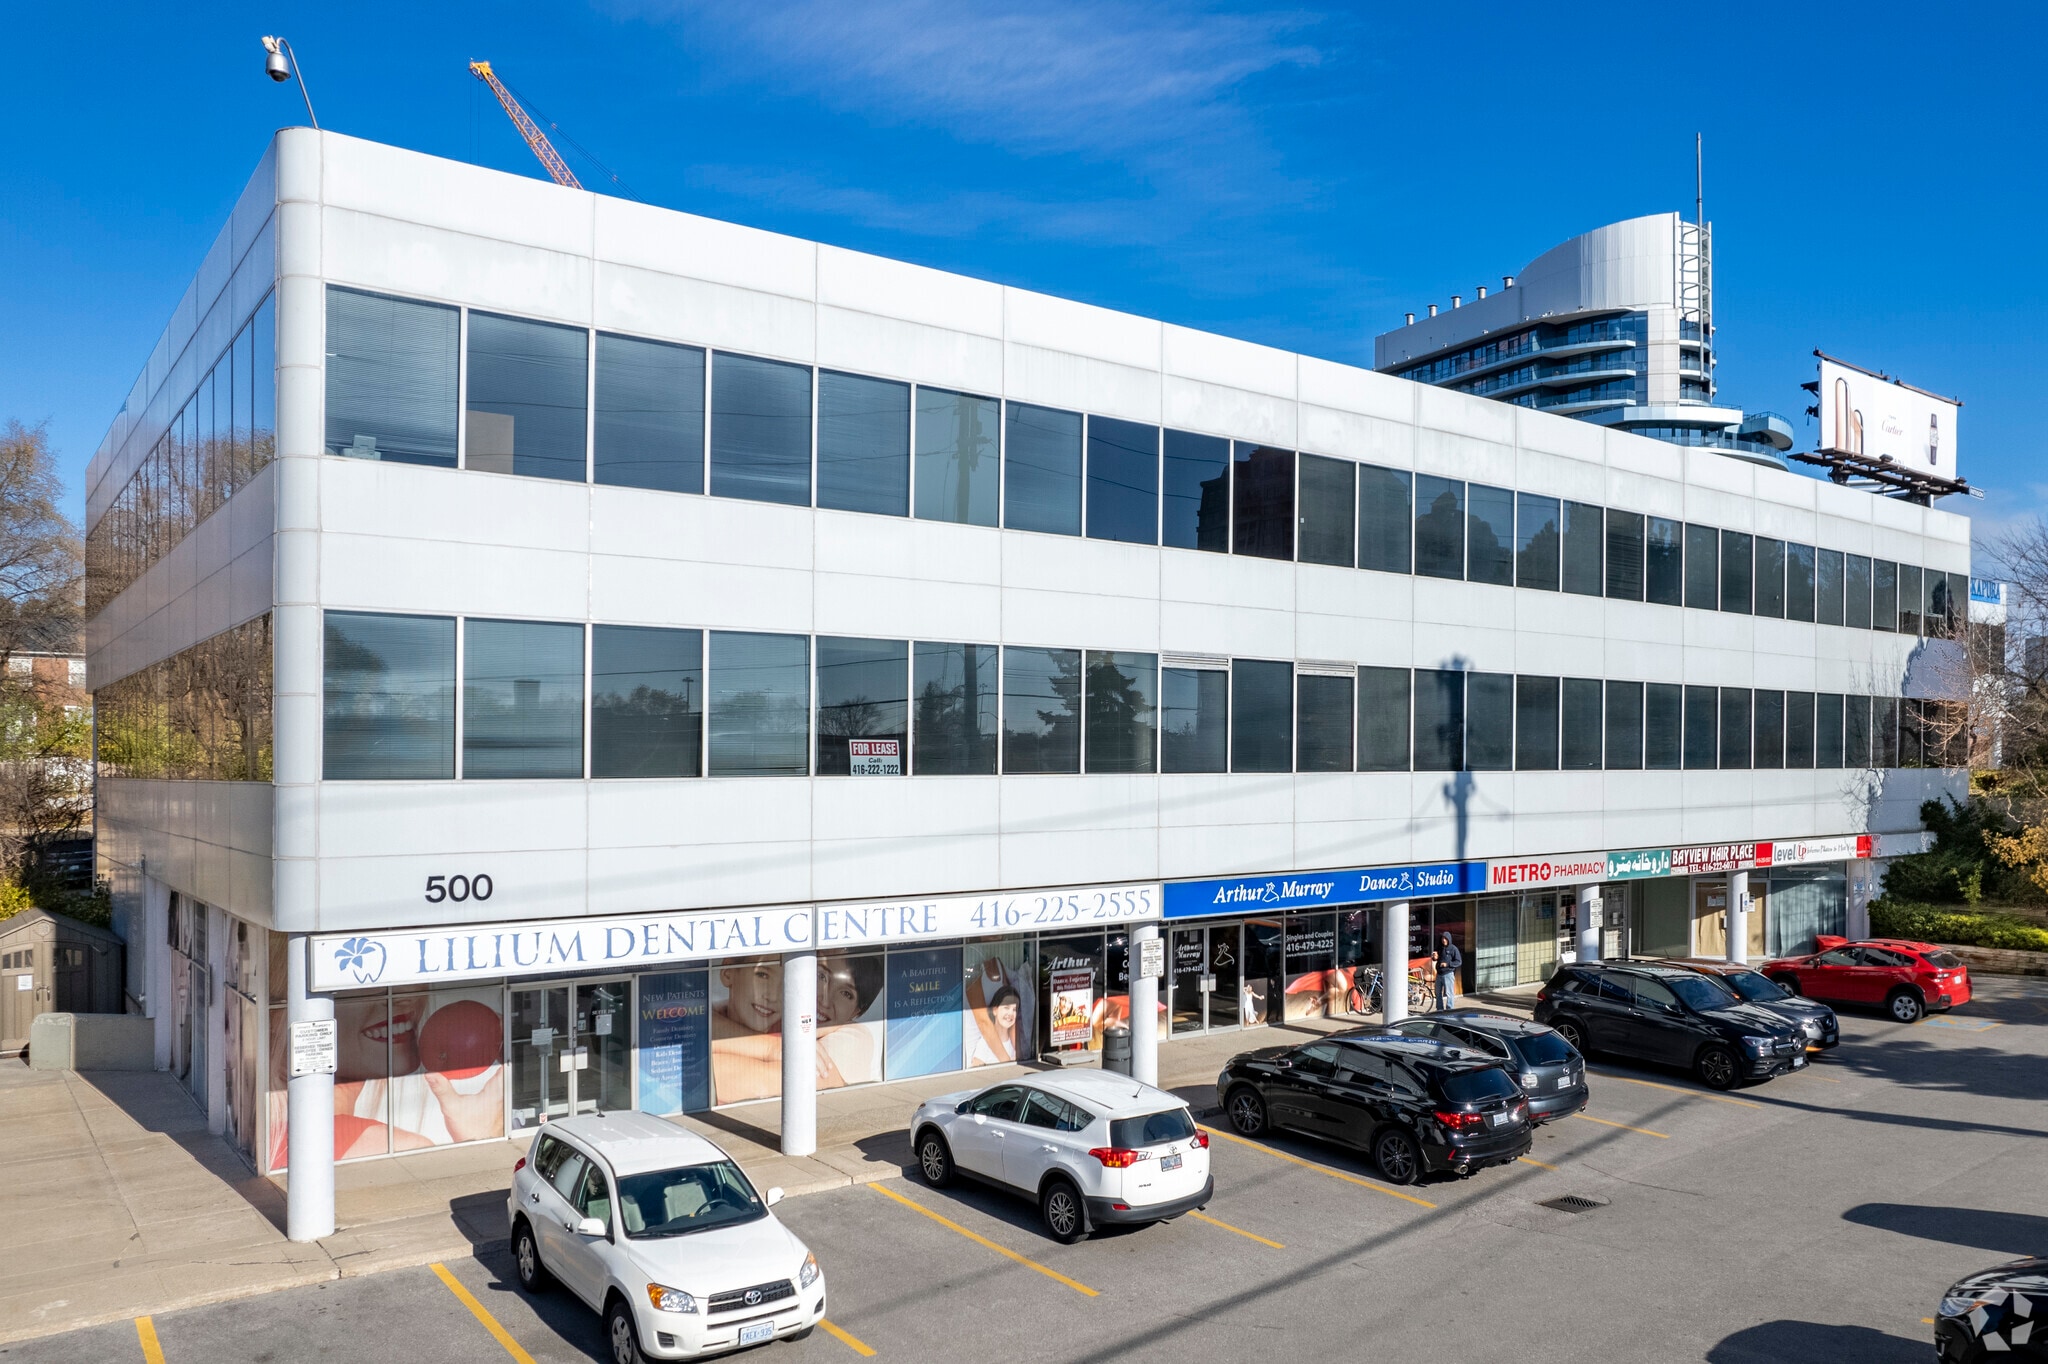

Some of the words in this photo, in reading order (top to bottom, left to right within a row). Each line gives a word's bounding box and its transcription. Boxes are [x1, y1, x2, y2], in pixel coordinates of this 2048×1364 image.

[852, 743, 870, 754] FOR
[872, 743, 896, 754] LEASE
[852, 764, 898, 774] 416-222-1222
[1672, 847, 1710, 866] BAYVIEW
[1711, 846, 1730, 862] HAIR
[1730, 844, 1754, 860] PLACE
[1774, 844, 1796, 862] level
[1493, 862, 1552, 884] METRO
[1554, 862, 1605, 877] PHARMACY
[424, 874, 493, 903] 500
[1213, 884, 1264, 904] Arthur
[1281, 880, 1332, 899] Murray
[1359, 876, 1398, 892] Dance
[1416, 870, 1454, 887] Studio
[416, 930, 588, 973] LILIUM
[602, 916, 771, 959] DENTAL
[784, 904, 938, 943] CENTRE
[970, 889, 1151, 928] 416-225-2555
[1286, 934, 1304, 942] Singles
[1305, 932, 1314, 940] and
[1286, 939, 1334, 952] 416-479-4225
[1043, 956, 1090, 971] Arthur
[902, 970, 908, 978] A
[910, 967, 948, 977] BEAUTIFUL
[909, 981, 940, 993] SMILE
[642, 993, 664, 1003] NEW
[667, 990, 705, 1000] PATIENTS
[910, 995, 954, 1006] REFLECTION
[642, 1005, 705, 1020] WELCOME
